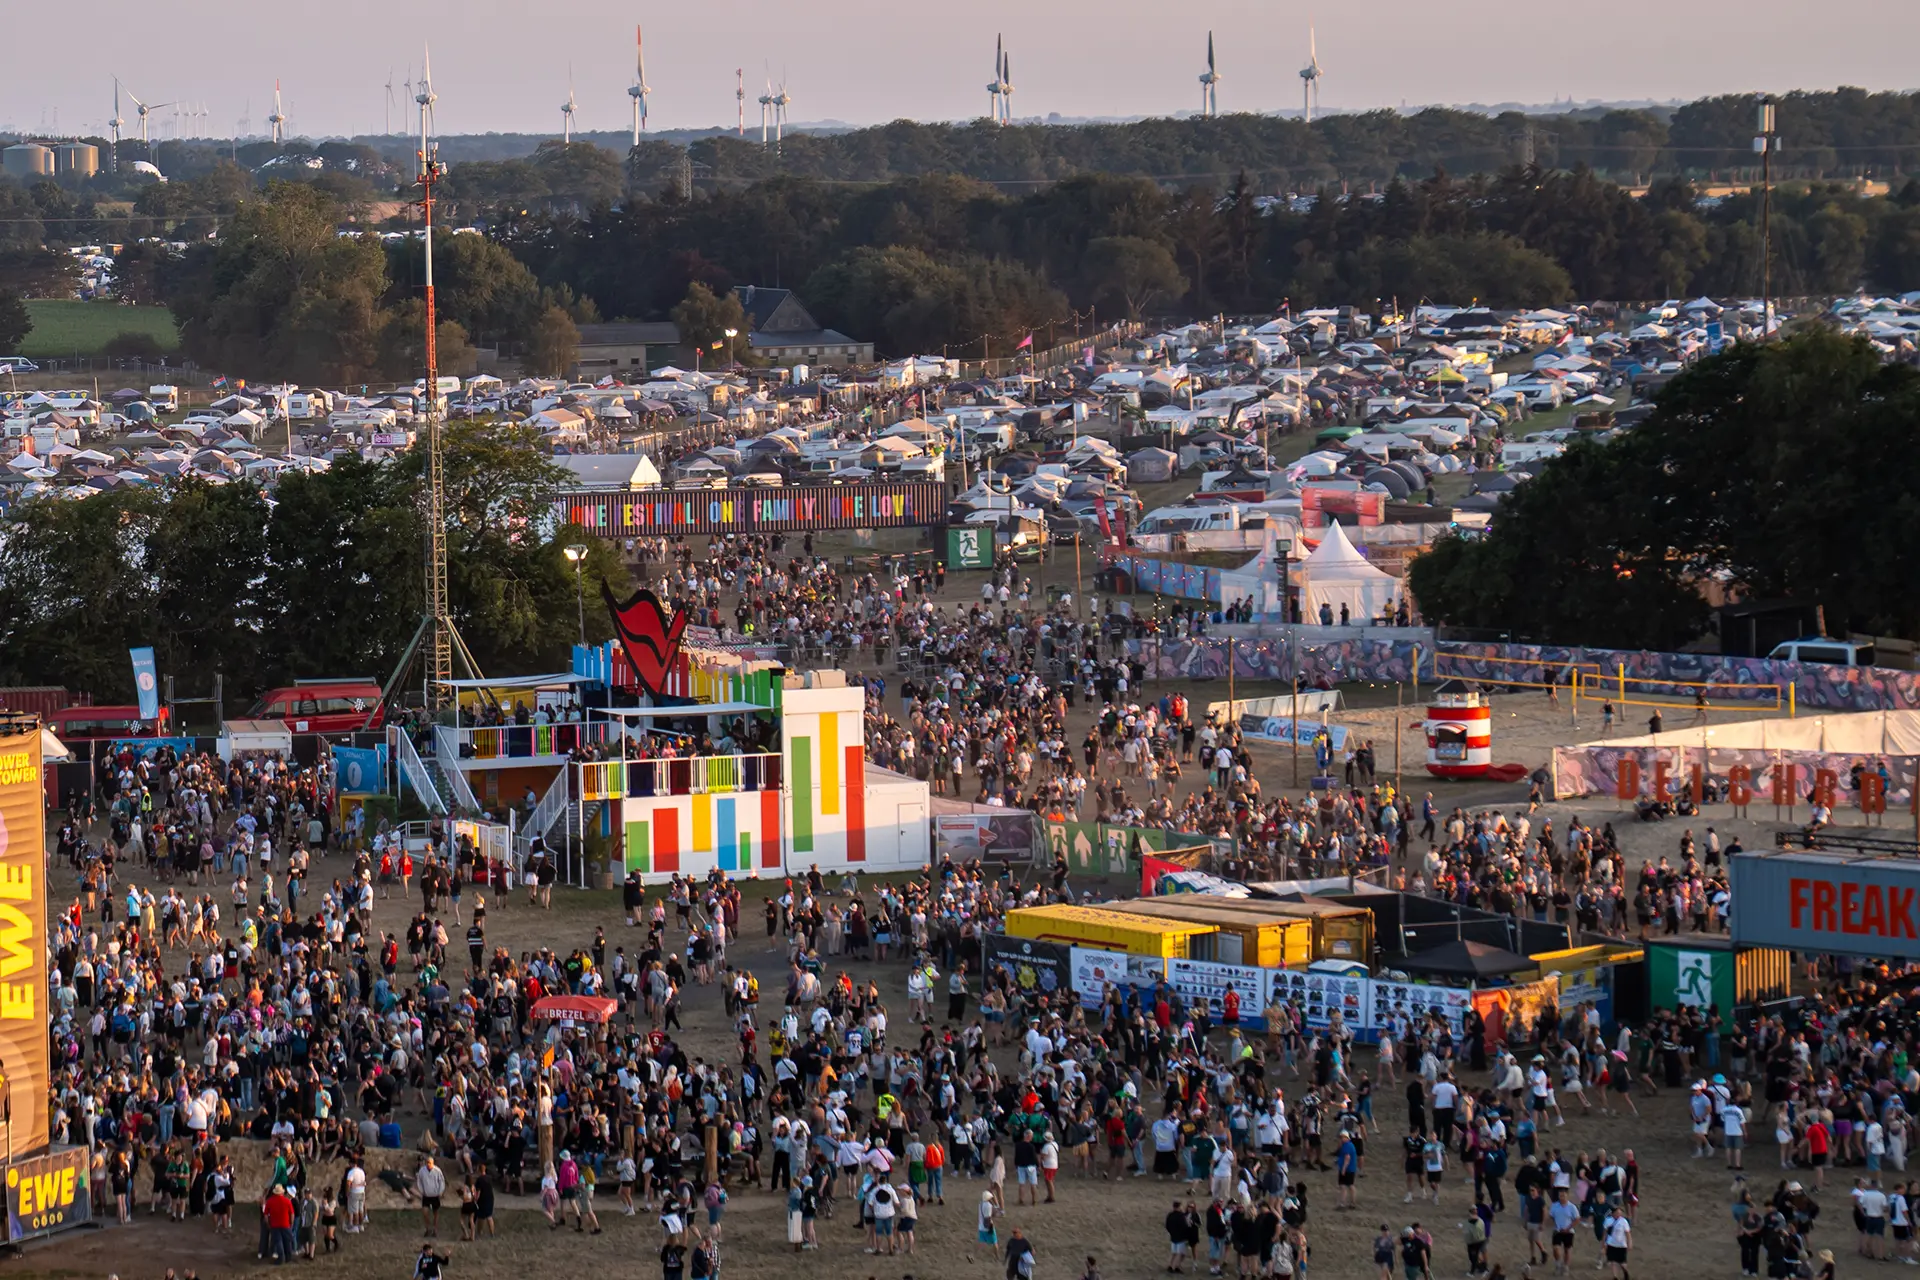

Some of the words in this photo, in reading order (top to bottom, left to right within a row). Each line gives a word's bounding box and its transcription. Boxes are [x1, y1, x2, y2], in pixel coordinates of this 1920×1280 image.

[571, 504, 607, 528] ONE
[614, 501, 700, 526] FESTIVAL.
[709, 500, 746, 523] ONE
[753, 497, 822, 522] FAMILY.
[831, 495, 864, 520] ONE
[871, 494, 919, 519] LOVE.
[1789, 877, 1920, 940] FREAK
[0, 862, 35, 1021] EWE
[549, 1008, 585, 1020] BREZEL
[653, 1036, 660, 1046] 9
[19, 1166, 75, 1217] EWE
